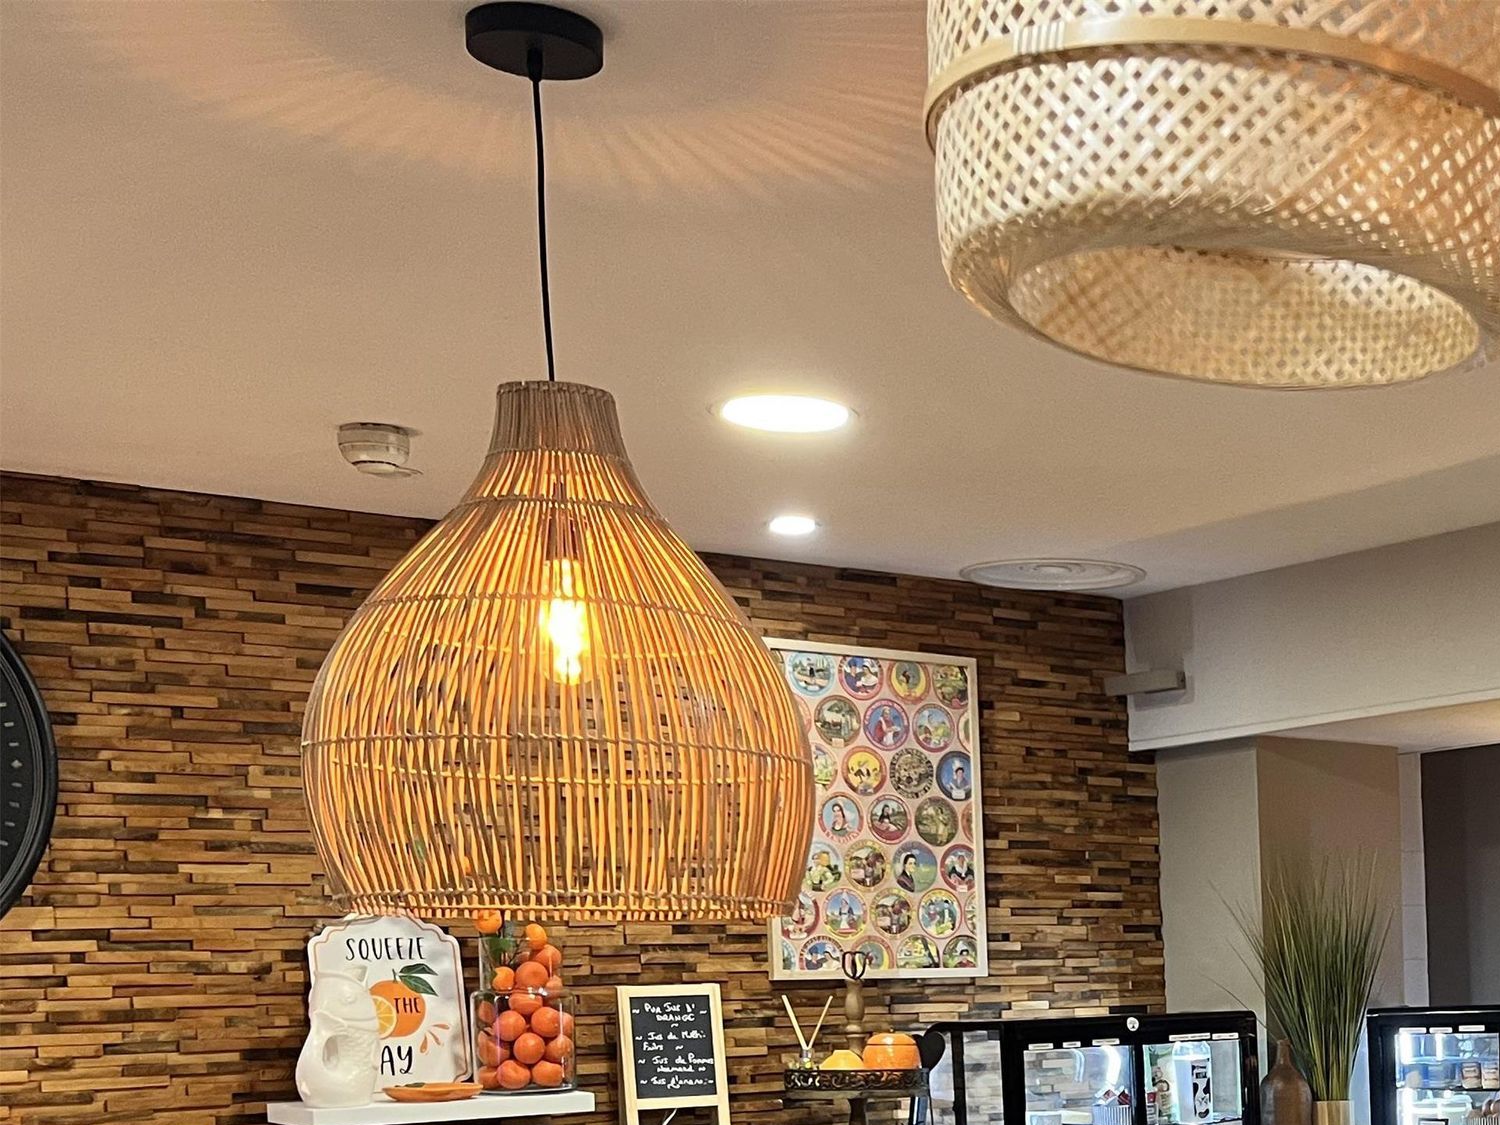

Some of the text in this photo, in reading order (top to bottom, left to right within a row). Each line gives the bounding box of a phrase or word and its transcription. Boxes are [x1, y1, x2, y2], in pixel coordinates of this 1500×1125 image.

[345, 936, 426, 962] SQUEEZE
[393, 997, 421, 1014] THE
[380, 1045, 413, 1076] AY
